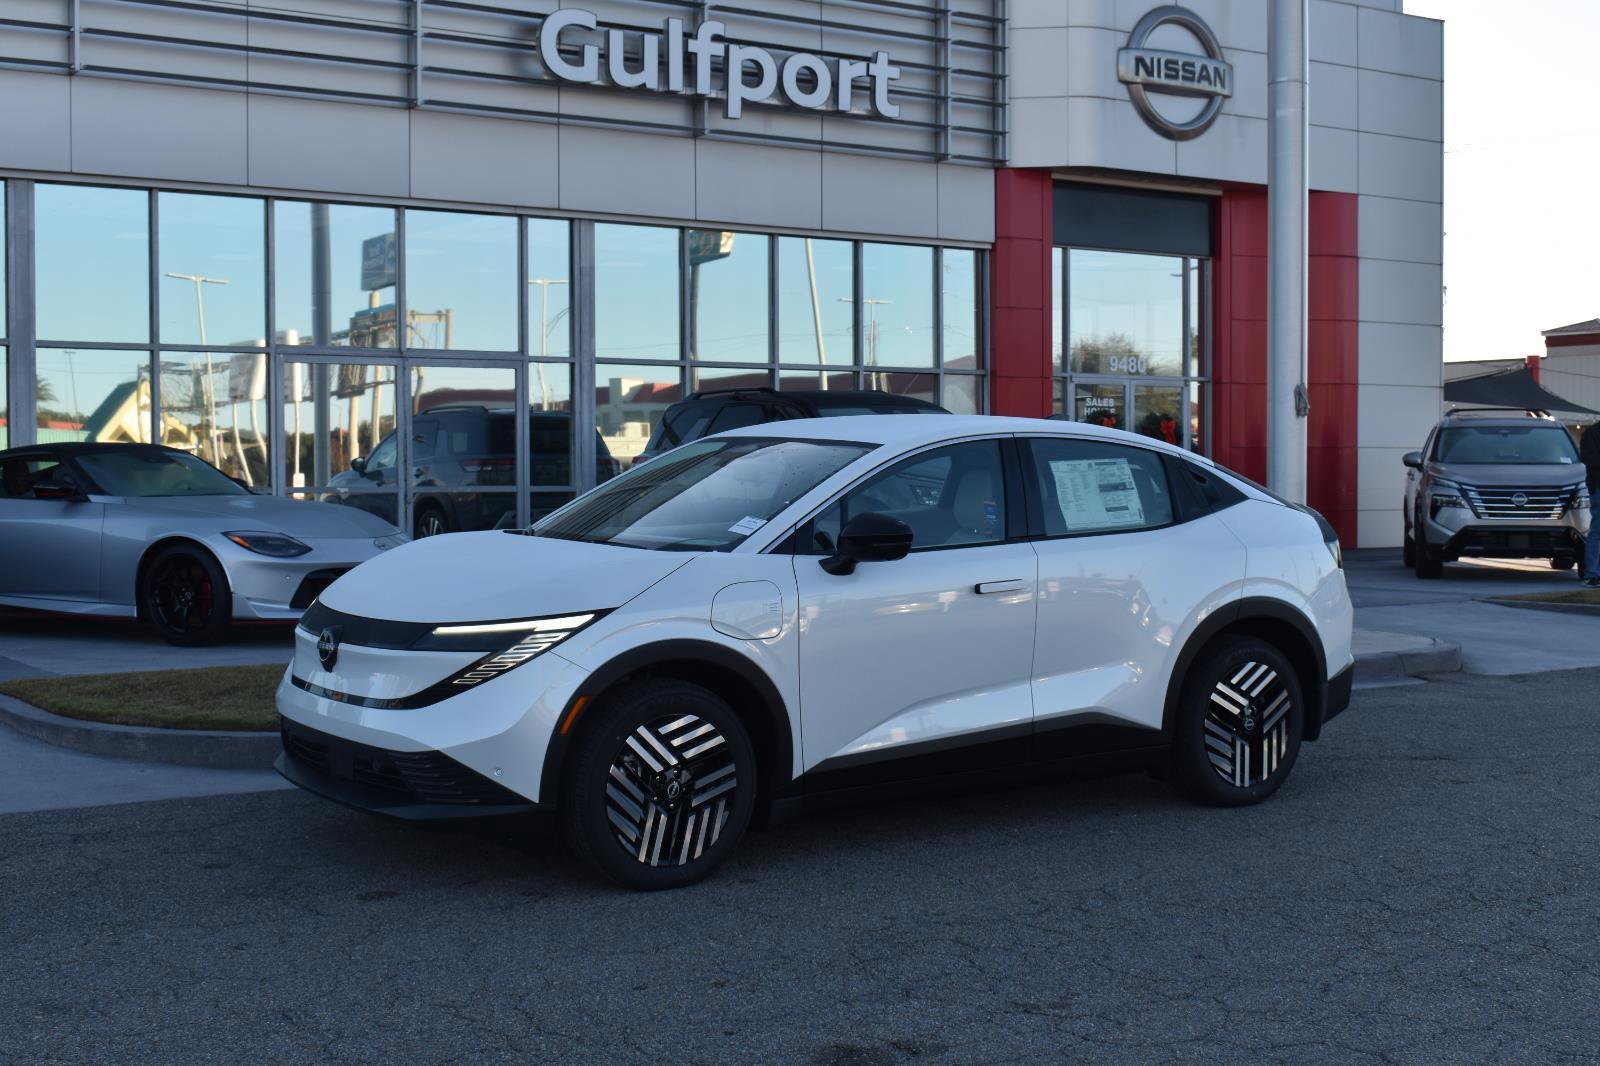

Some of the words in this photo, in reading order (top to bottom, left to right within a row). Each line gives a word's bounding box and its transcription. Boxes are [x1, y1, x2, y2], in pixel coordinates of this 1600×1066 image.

[539, 7, 901, 120] Gulfport
[1134, 55, 1227, 90] NISSAN
[1109, 355, 1147, 373] 9480
[1085, 397, 1115, 407] SALES
